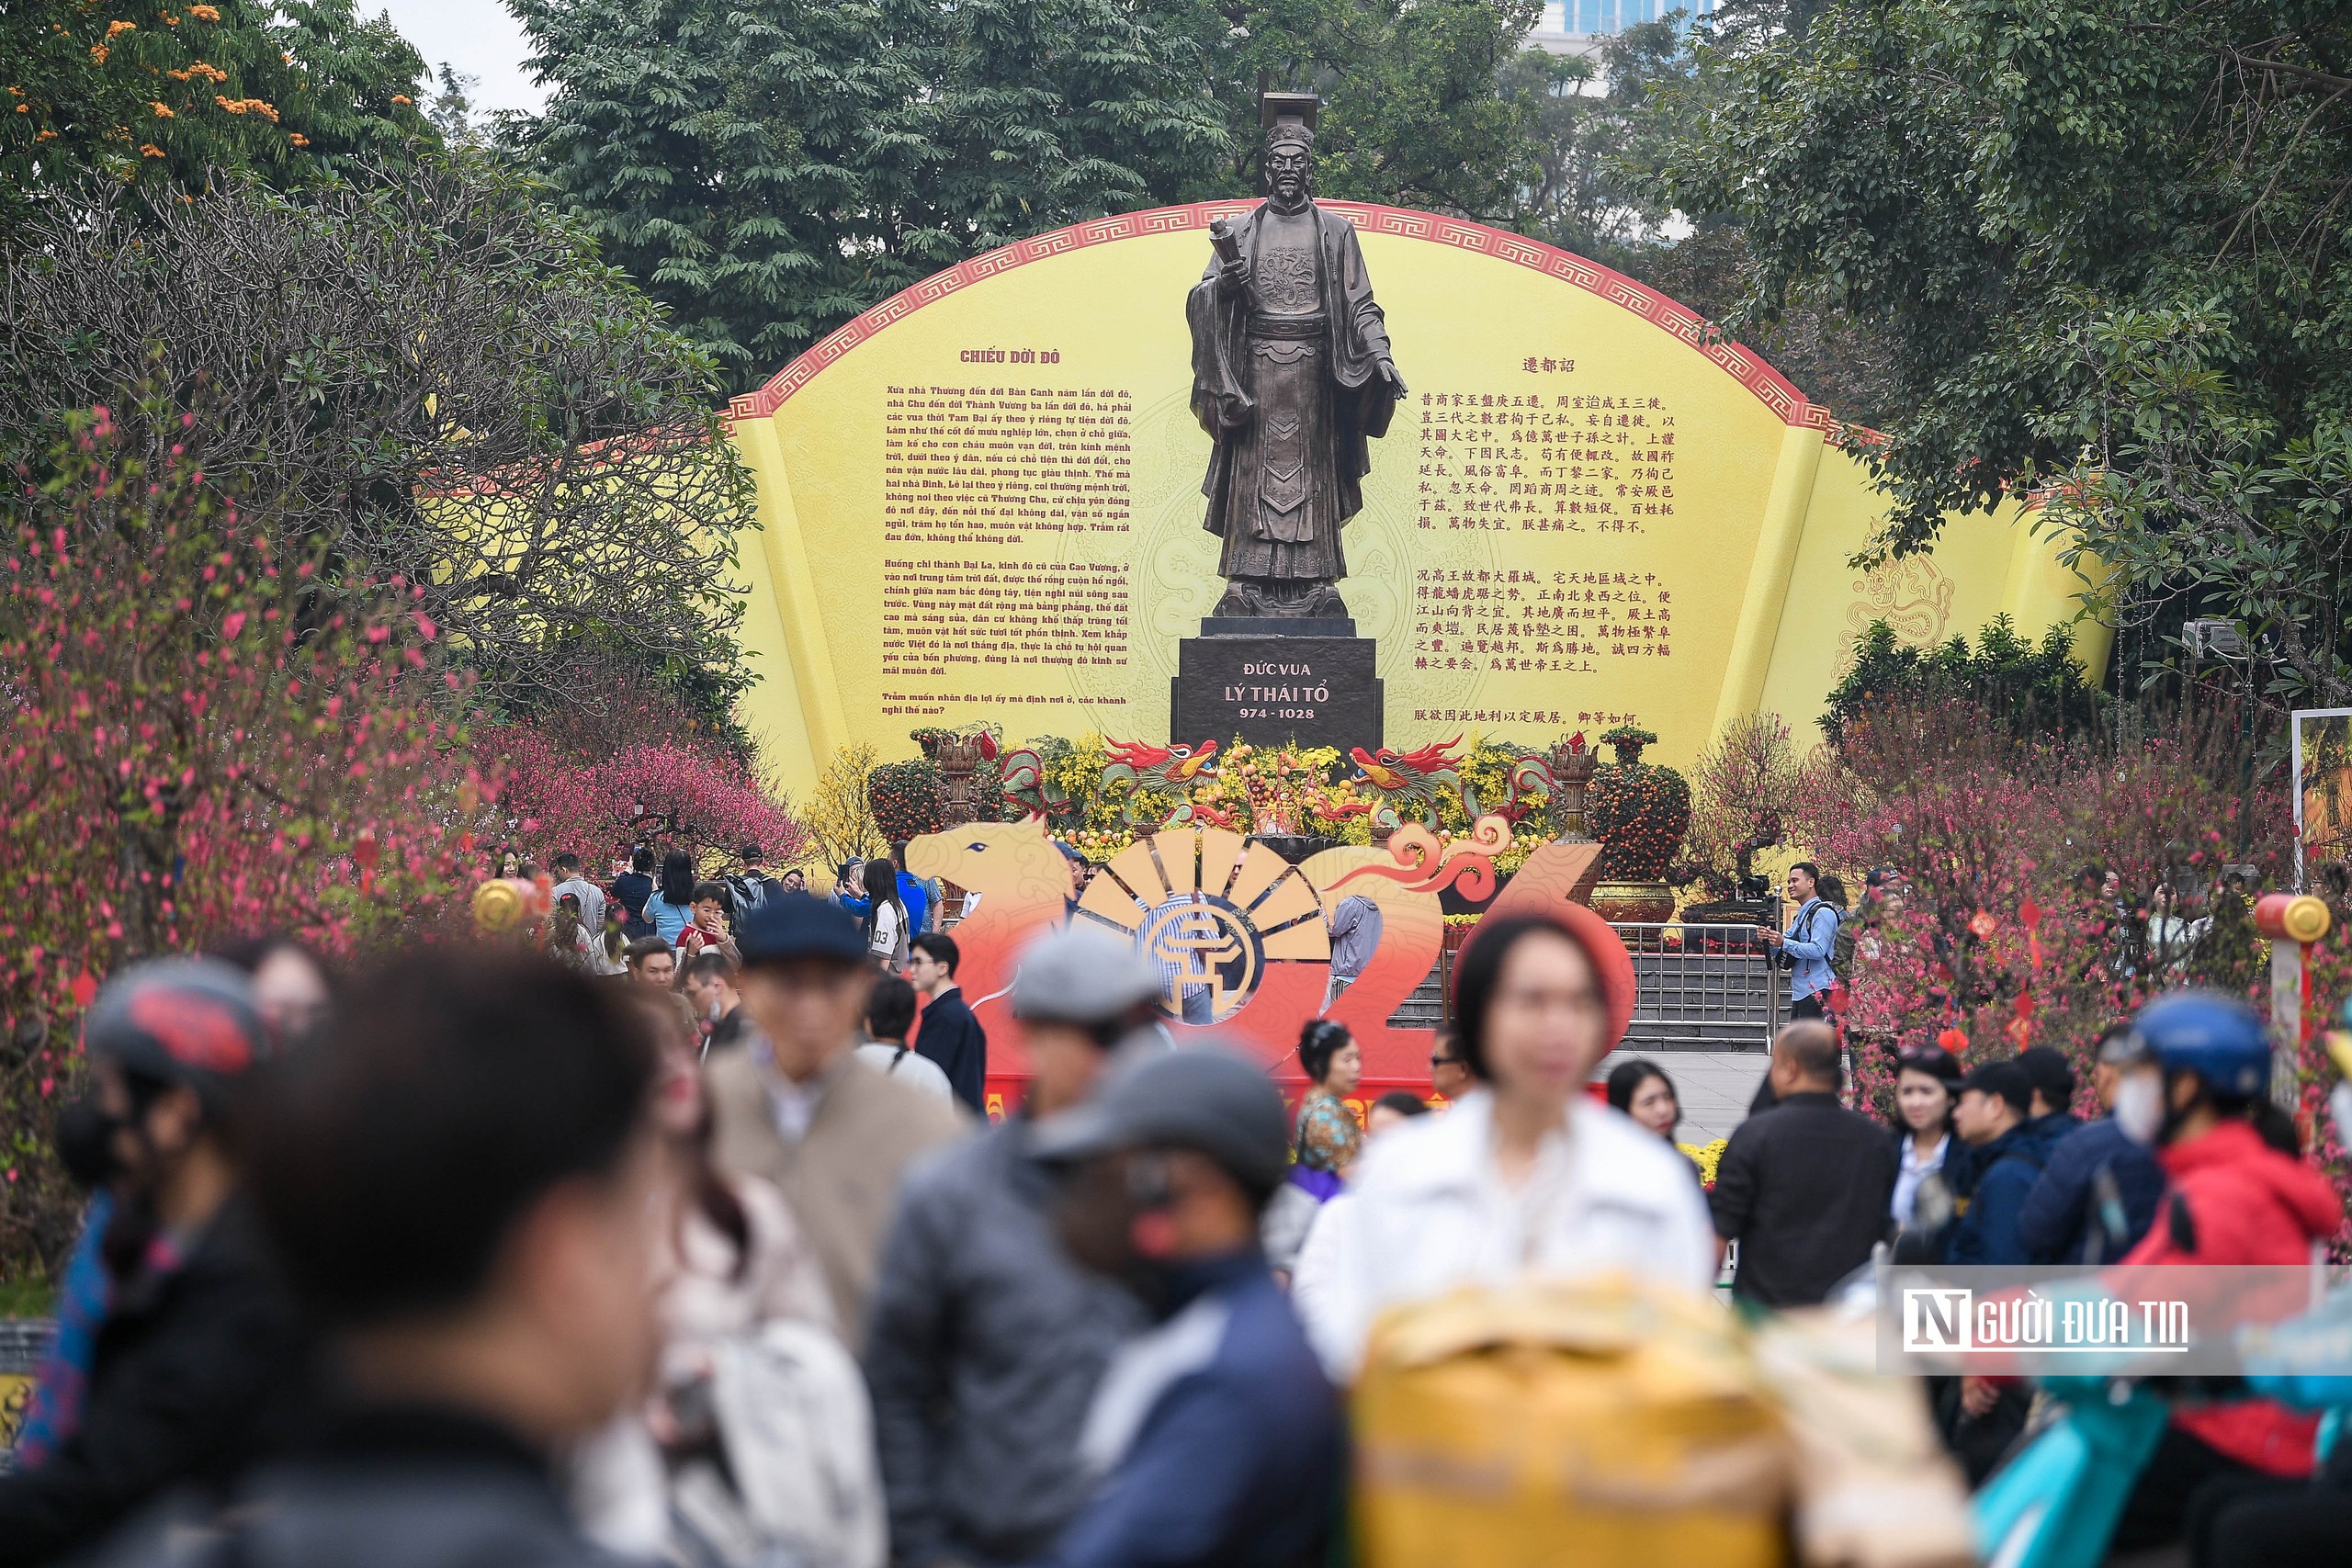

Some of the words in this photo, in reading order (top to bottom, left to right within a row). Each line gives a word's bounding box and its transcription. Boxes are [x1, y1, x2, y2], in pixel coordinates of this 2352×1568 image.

[960, 346, 1004, 363] CHIẾU
[1010, 348, 1035, 363] DỜI
[1040, 348, 1060, 364] ĐÔ
[1521, 356, 1575, 374] 遷都詔
[887, 385, 904, 394] Xưa
[908, 385, 925, 394] nhà
[930, 386, 965, 397] Thương
[968, 385, 986, 395] đến
[989, 387, 1003, 395] đời
[1008, 387, 1025, 396] Bàn
[1030, 388, 1053, 397] Canh
[1057, 389, 1077, 397] năm
[1081, 387, 1095, 397] lần
[1100, 389, 1114, 398] dời
[887, 399, 904, 407] nhà
[907, 399, 925, 408] Chu
[928, 398, 944, 408] đến
[948, 400, 962, 408] đời
[965, 400, 995, 409] Thành
[998, 400, 1027, 412] Vương
[1030, 400, 1041, 410] ba
[1045, 400, 1058, 410] lần
[1062, 401, 1076, 410] dời
[1096, 402, 1108, 411] há
[1111, 401, 1131, 413] phải
[886, 438, 902, 447] làm
[907, 438, 918, 447] kế
[922, 439, 938, 447] cho
[962, 440, 985, 448] cháu
[989, 441, 1013, 449] muôn
[1017, 443, 1035, 451] vạn
[1058, 442, 1077, 450] trên
[1080, 442, 1101, 451] kính
[1104, 443, 1130, 453] mệnh
[886, 465, 902, 474] nên
[906, 466, 923, 476] vận
[927, 466, 949, 475] nước
[952, 466, 967, 475] lâu
[990, 468, 1019, 478] phong
[1023, 468, 1037, 479] tục
[1041, 468, 1060, 479] giàu
[1094, 468, 1113, 478] Thế
[1116, 469, 1130, 479] mà
[885, 492, 913, 502] không
[916, 492, 931, 501] noi
[933, 493, 953, 502] theo
[956, 493, 974, 503] việc
[977, 493, 989, 502] cũ
[990, 494, 1025, 504] Thương
[1052, 495, 1064, 503] cứ
[1066, 495, 1085, 506] chịu
[1088, 496, 1104, 506] yên
[1107, 496, 1130, 507] đóng
[916, 559, 931, 568] chi
[933, 559, 960, 569] thành
[963, 560, 978, 570] Đại
[998, 560, 1018, 570] kinh
[1022, 561, 1033, 570] đô
[1035, 561, 1046, 570] cũ
[1069, 562, 1086, 570] Cao
[884, 585, 910, 594] chính
[912, 586, 933, 596] giữa
[959, 585, 975, 595] bắc
[978, 587, 1001, 598] đông
[1023, 588, 1041, 599] tiện
[1045, 589, 1065, 600] nghi
[1069, 589, 1083, 597] núi
[1086, 589, 1108, 600] sông
[912, 599, 935, 610] Vùng
[938, 600, 956, 610] này
[958, 601, 976, 611] mặt
[978, 599, 992, 609] đất
[995, 601, 1016, 611] rộng
[1019, 601, 1033, 610] mà
[1096, 602, 1111, 611] thế
[1114, 602, 1128, 612] đất
[906, 626, 932, 635] muôn
[934, 626, 949, 637] vật
[952, 626, 967, 636] hết
[970, 626, 986, 636] sức
[989, 627, 1007, 636] tươi
[1010, 626, 1022, 636] tốt
[1081, 629, 1101, 637] Xem
[882, 651, 899, 662] yếu
[922, 652, 939, 661] bốn
[984, 654, 1007, 664] đúng
[1011, 654, 1019, 662] là
[1023, 655, 1037, 663] nơi
[1041, 655, 1073, 666] thượng
[1077, 656, 1087, 664] đô
[1090, 656, 1112, 665] kinh
[1115, 657, 1127, 665] sư
[882, 666, 899, 674] mãi
[901, 666, 927, 674] muôn
[1243, 660, 1276, 675] ĐỨC
[1279, 664, 1311, 675] VUA
[1225, 682, 1245, 702] LÝ
[1250, 683, 1298, 702] THÁI
[1303, 679, 1329, 702] TỔ
[881, 705, 902, 716] nghĩ
[904, 705, 919, 714] thế
[922, 705, 944, 715] nào?
[1239, 708, 1267, 718] 974
[1279, 709, 1315, 719] 1028
[875, 931, 888, 944] 03
